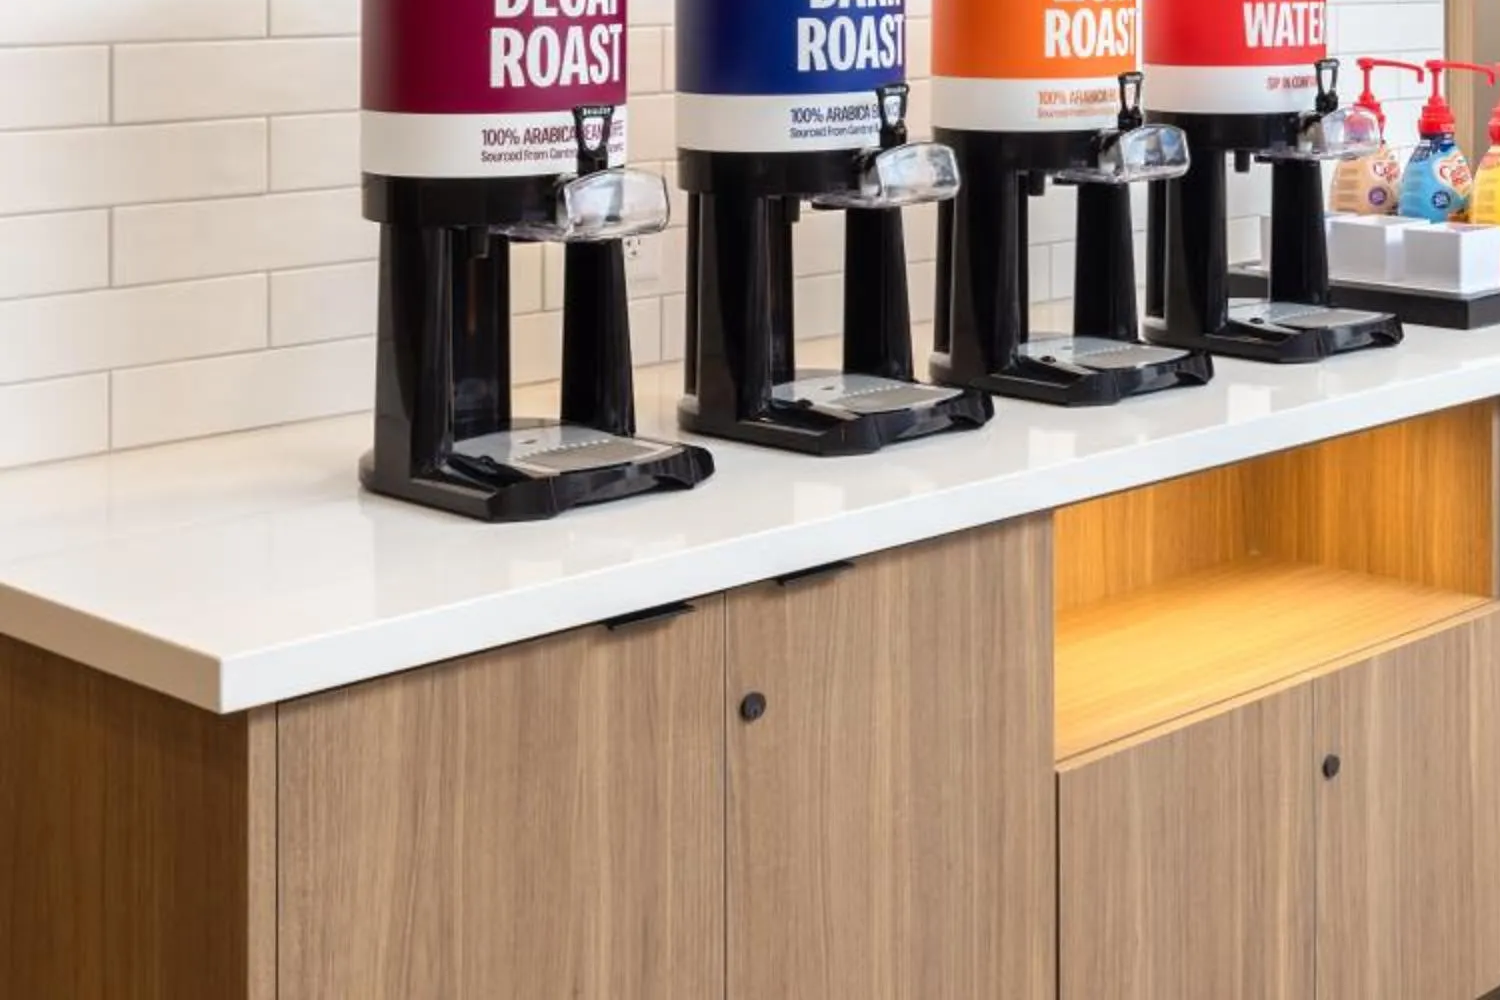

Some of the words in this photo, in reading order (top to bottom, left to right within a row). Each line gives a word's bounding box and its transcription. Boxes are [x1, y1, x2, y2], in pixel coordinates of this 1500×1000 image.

[489, 23, 623, 88] ROAST
[796, 13, 905, 72] ROAST
[1044, 7, 1139, 59] ROAST
[481, 127, 521, 147] 100%
[523, 124, 577, 146] ARABICA
[790, 106, 824, 123] 100%
[826, 103, 870, 121] ARABICA
